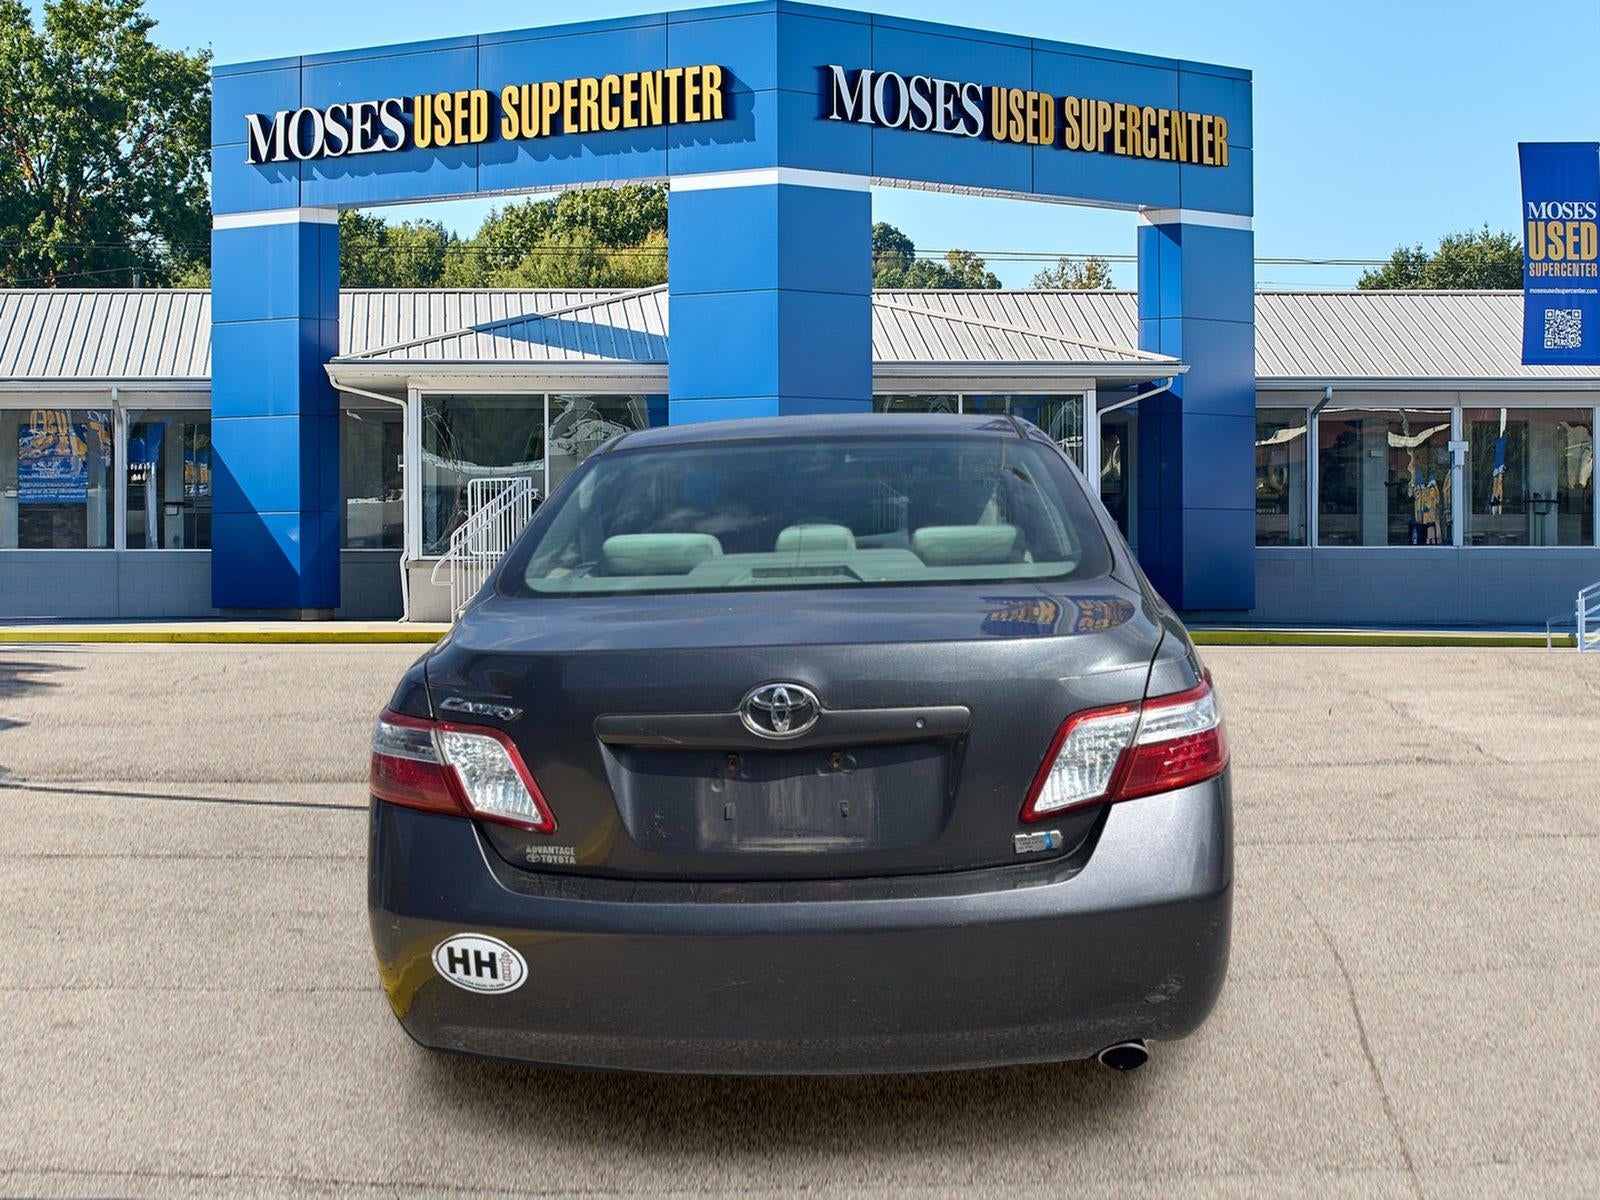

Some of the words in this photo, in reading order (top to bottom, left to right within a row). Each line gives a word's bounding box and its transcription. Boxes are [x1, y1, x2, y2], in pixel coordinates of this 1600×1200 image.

[244, 98, 405, 165] MOSES
[413, 88, 489, 149] USED
[500, 64, 724, 142] SUPERCENTER
[828, 64, 985, 138] MOSES
[991, 86, 1055, 146] USED
[1064, 95, 1229, 167] SUPERCENTER
[1527, 201, 1597, 220] MOSES
[1528, 221, 1598, 261] USED
[1529, 262, 1598, 278] SUPERCENTER
[439, 696, 524, 721] CAMRY
[525, 845, 576, 856] ADVANTAGE
[541, 855, 577, 865] TOYOTA
[446, 946, 499, 980] HH
